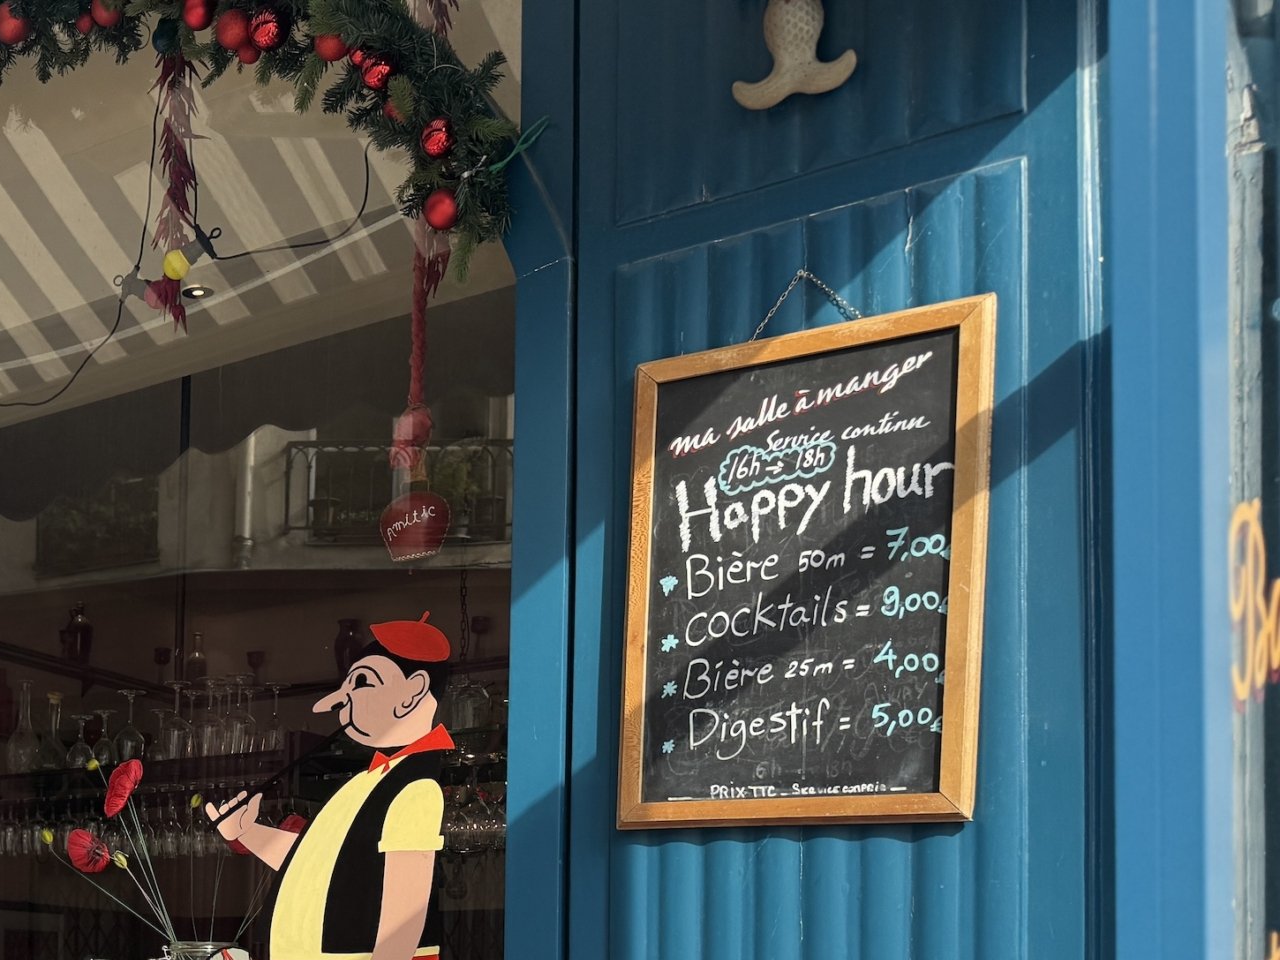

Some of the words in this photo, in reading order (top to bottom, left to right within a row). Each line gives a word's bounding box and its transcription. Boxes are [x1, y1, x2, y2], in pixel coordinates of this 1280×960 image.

[669, 427, 720, 458] ma
[726, 395, 791, 438] salle
[816, 351, 933, 406] manger
[765, 426, 835, 453] Service
[841, 411, 931, 440] continu
[728, 452, 760, 483] 16h
[795, 448, 825, 471] 18h
[675, 475, 832, 553] Happy
[842, 445, 955, 514] hour
[685, 551, 779, 600] Bière
[683, 657, 774, 700] Bière
[688, 698, 830, 760] Digestif
[748, 785, 777, 798] TTC
